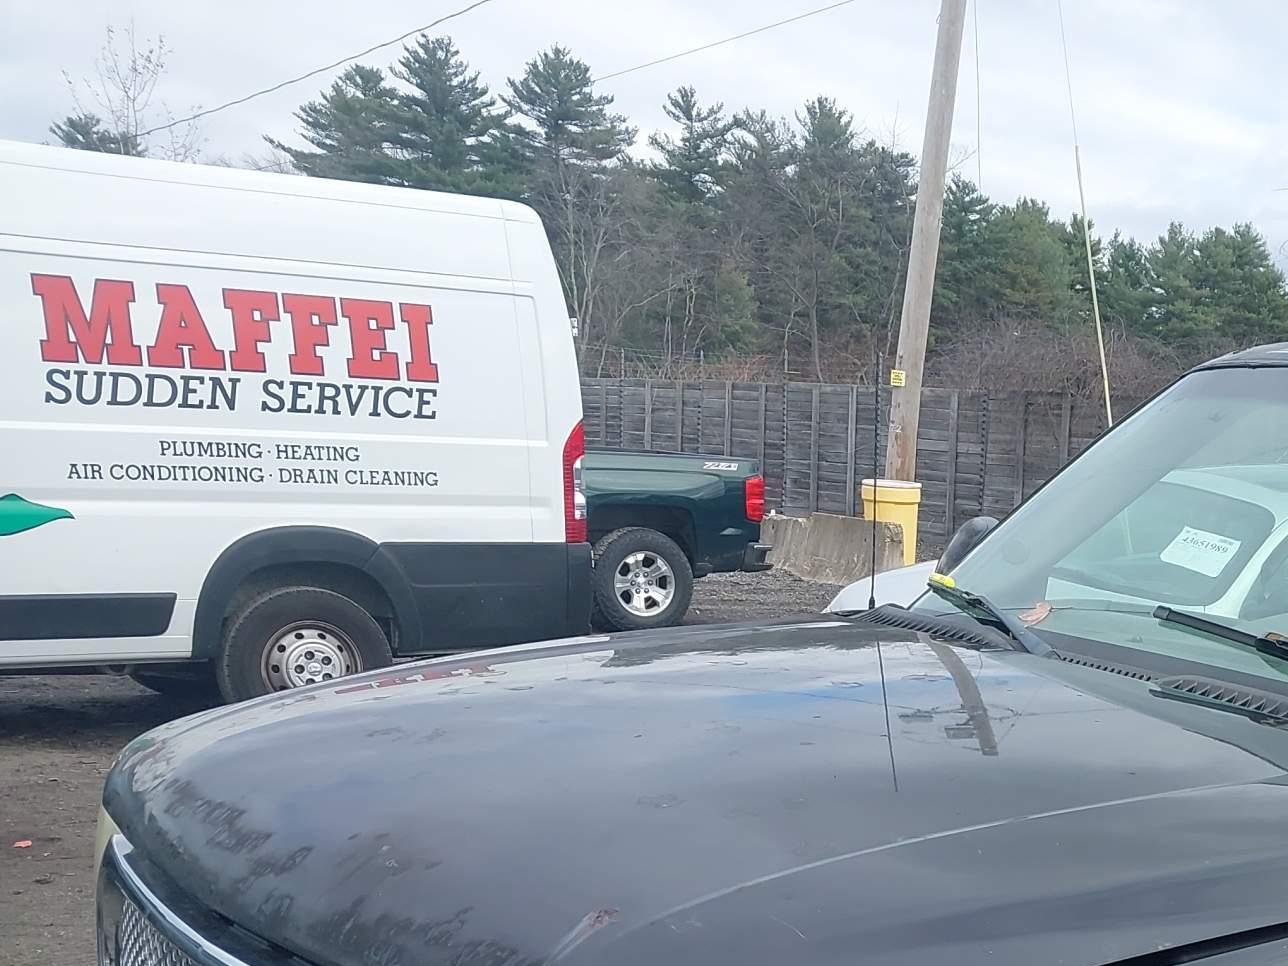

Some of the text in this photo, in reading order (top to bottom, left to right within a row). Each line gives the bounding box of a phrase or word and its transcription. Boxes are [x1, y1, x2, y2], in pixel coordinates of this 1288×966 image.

[30, 273, 440, 383] MAFFEI
[44, 367, 439, 419] SUDDEN SERVICE
[159, 440, 360, 462] PLUMBING HEATING
[67, 464, 439, 487] AIR CONDITIONING DRAIN CLEANING
